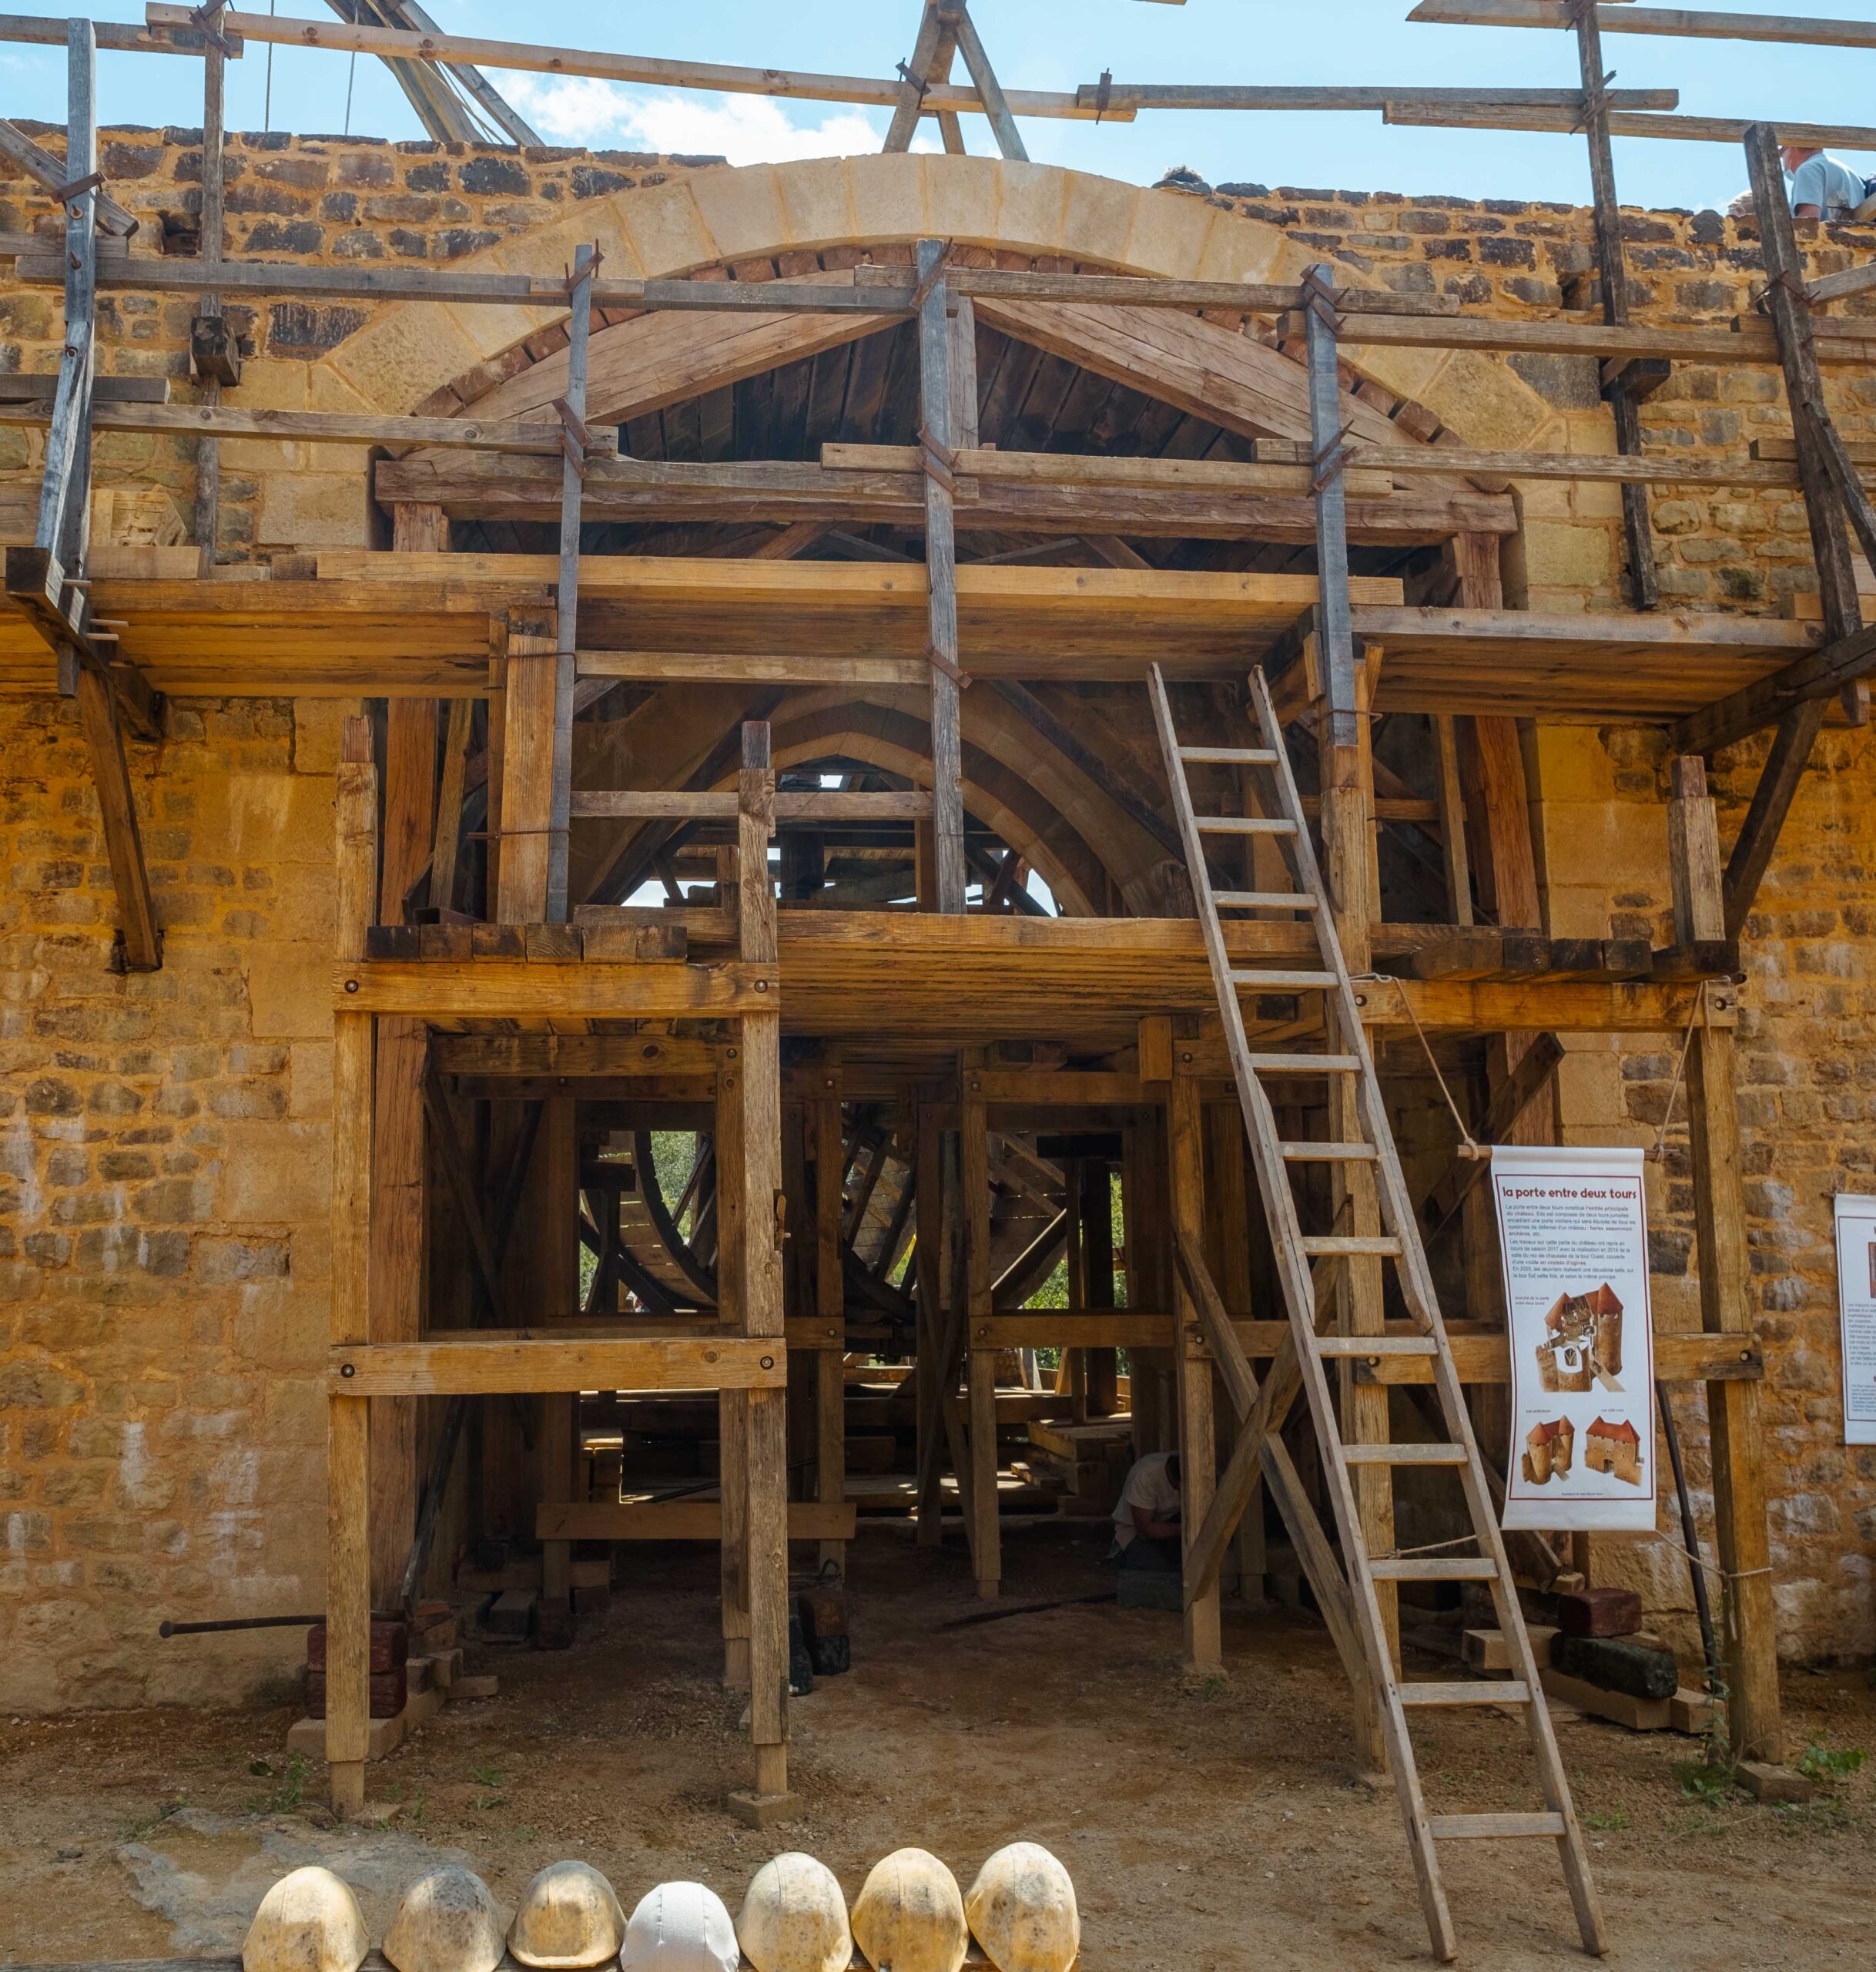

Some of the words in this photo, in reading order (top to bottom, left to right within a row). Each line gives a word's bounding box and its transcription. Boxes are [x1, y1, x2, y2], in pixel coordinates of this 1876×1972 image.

[1502, 1186, 1513, 1196] la
[1516, 1187, 1546, 1199] porte
[1549, 1188, 1577, 1198] entre
[1580, 1188, 1606, 1198] deux
[1610, 1189, 1636, 1199] tours
